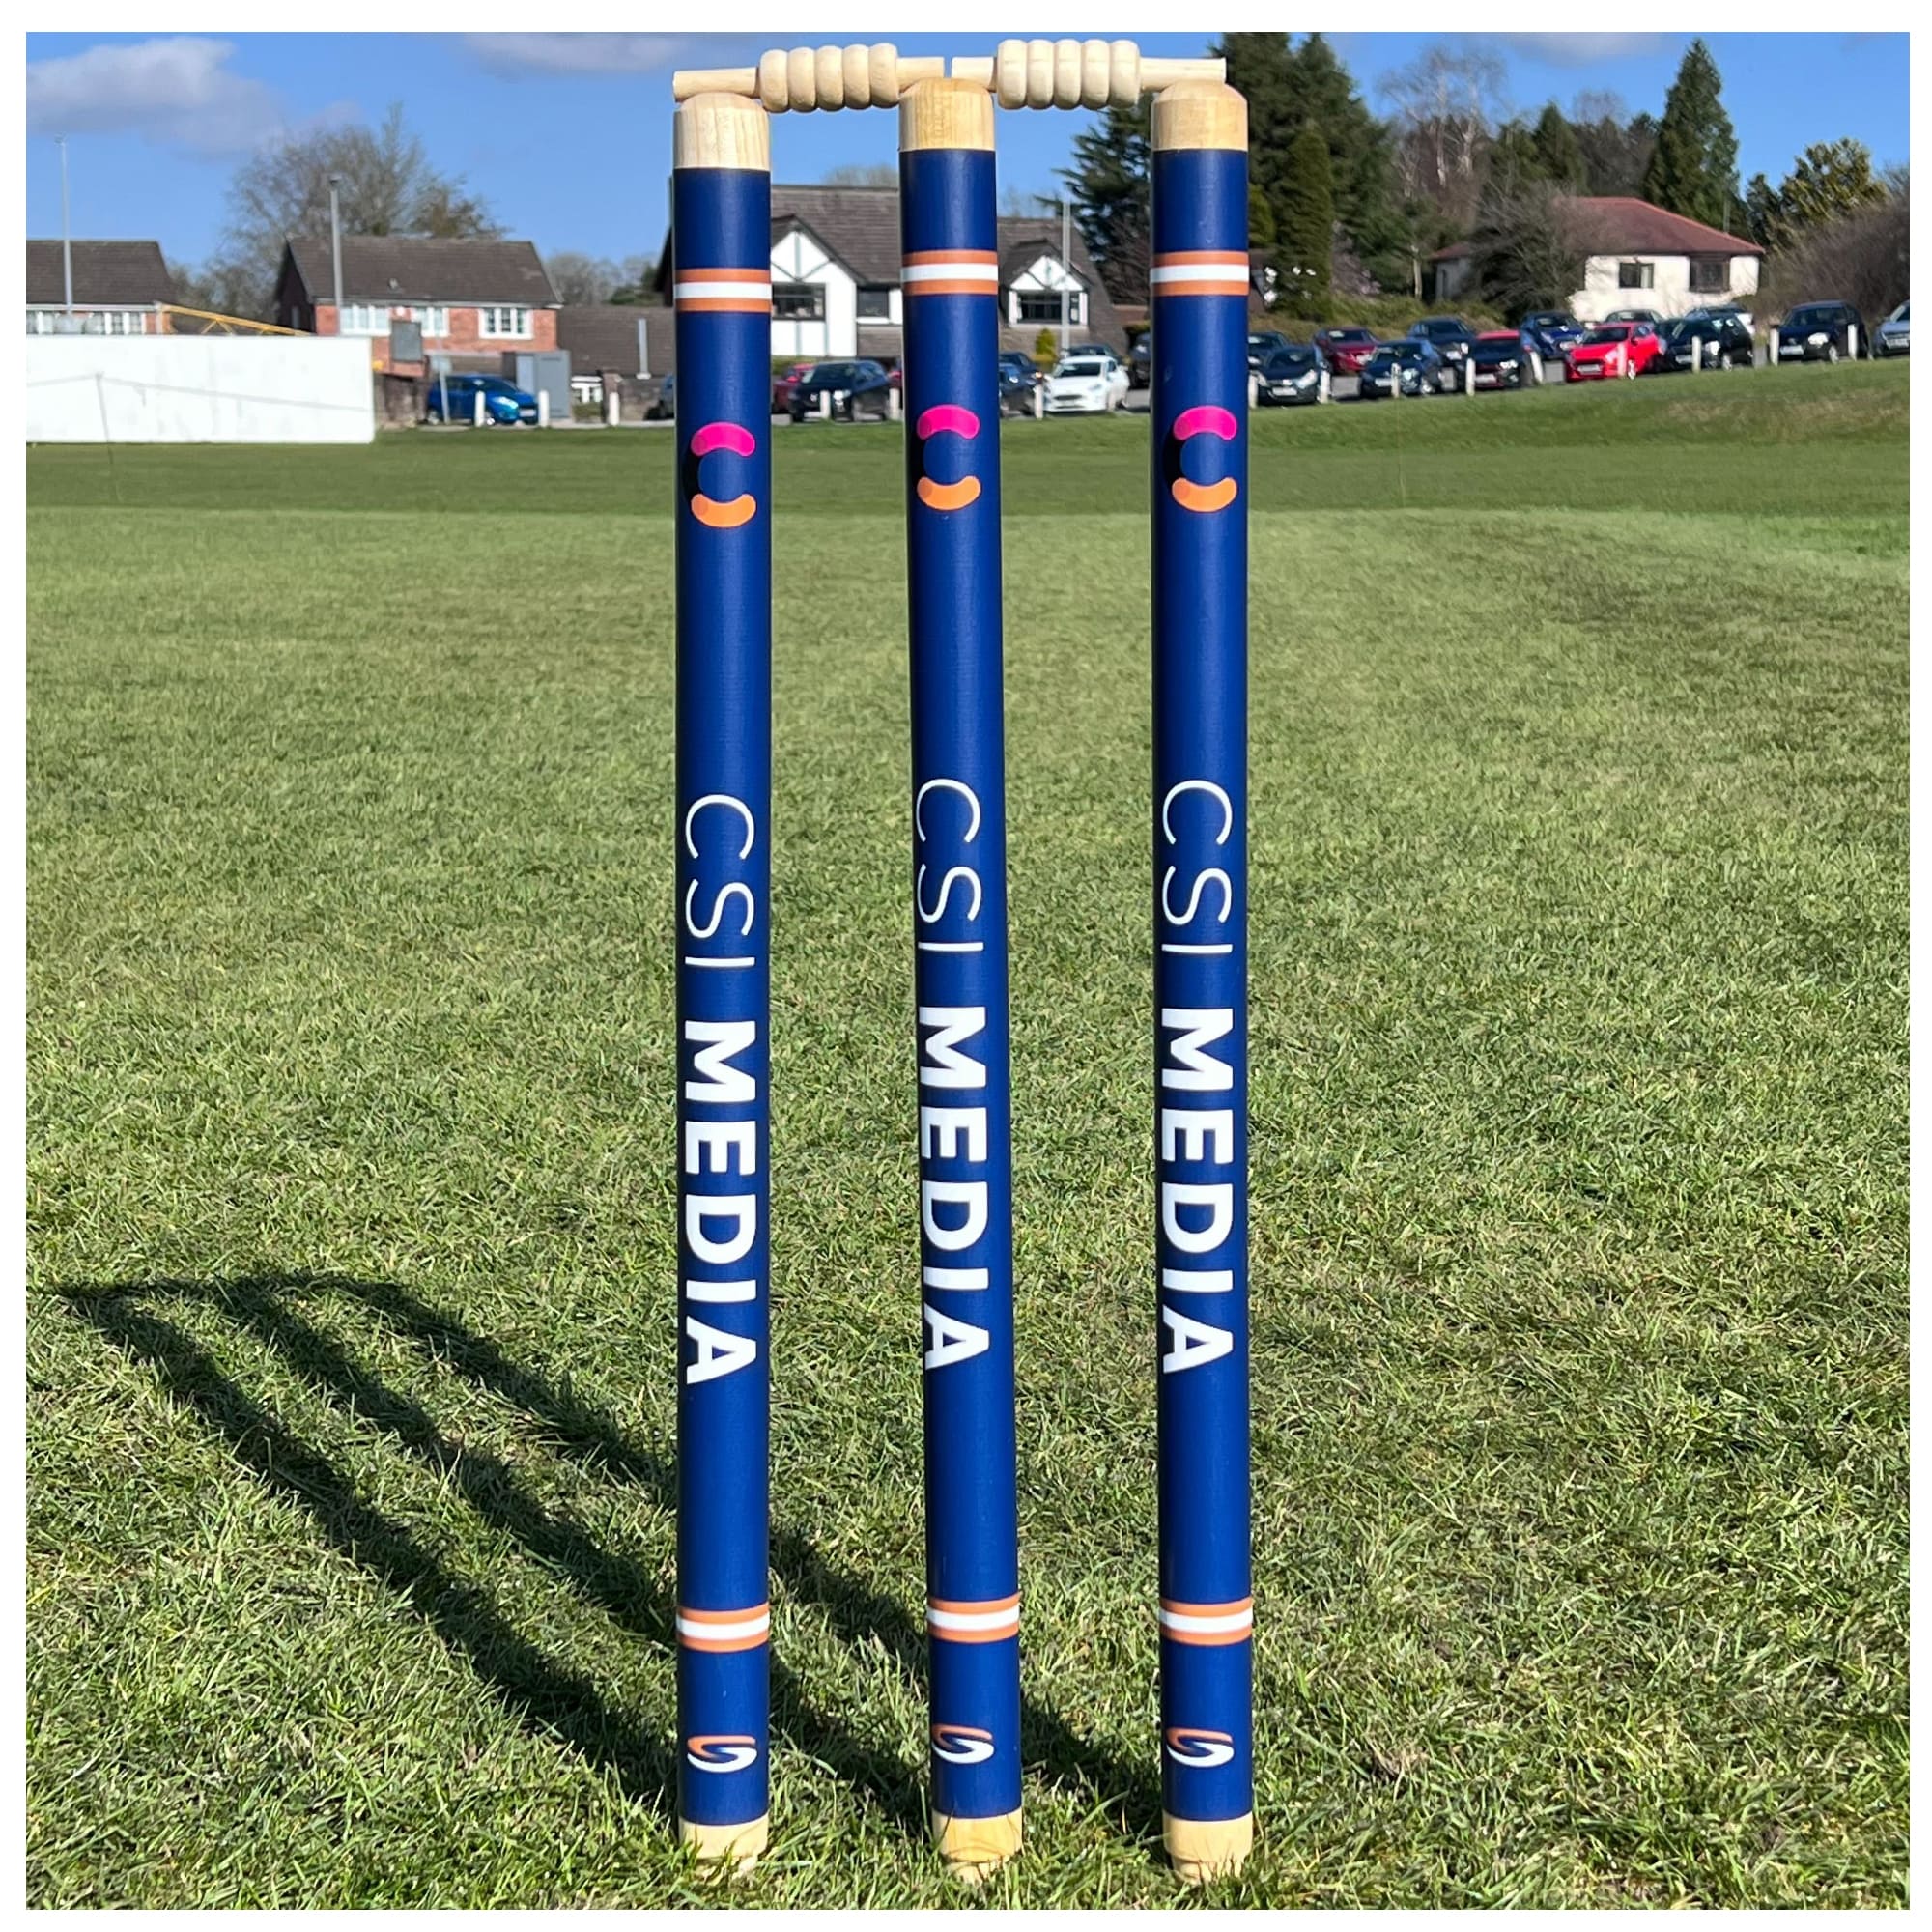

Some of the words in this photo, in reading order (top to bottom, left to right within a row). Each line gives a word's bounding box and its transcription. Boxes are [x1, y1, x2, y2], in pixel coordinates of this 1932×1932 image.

[685, 794, 755, 967] CSI
[916, 778, 984, 952] CSI
[1162, 780, 1233, 954] CSI
[685, 1020, 757, 1385] MEDIA
[919, 1006, 990, 1369] MEDIA
[1162, 1008, 1234, 1373] MEDIA
